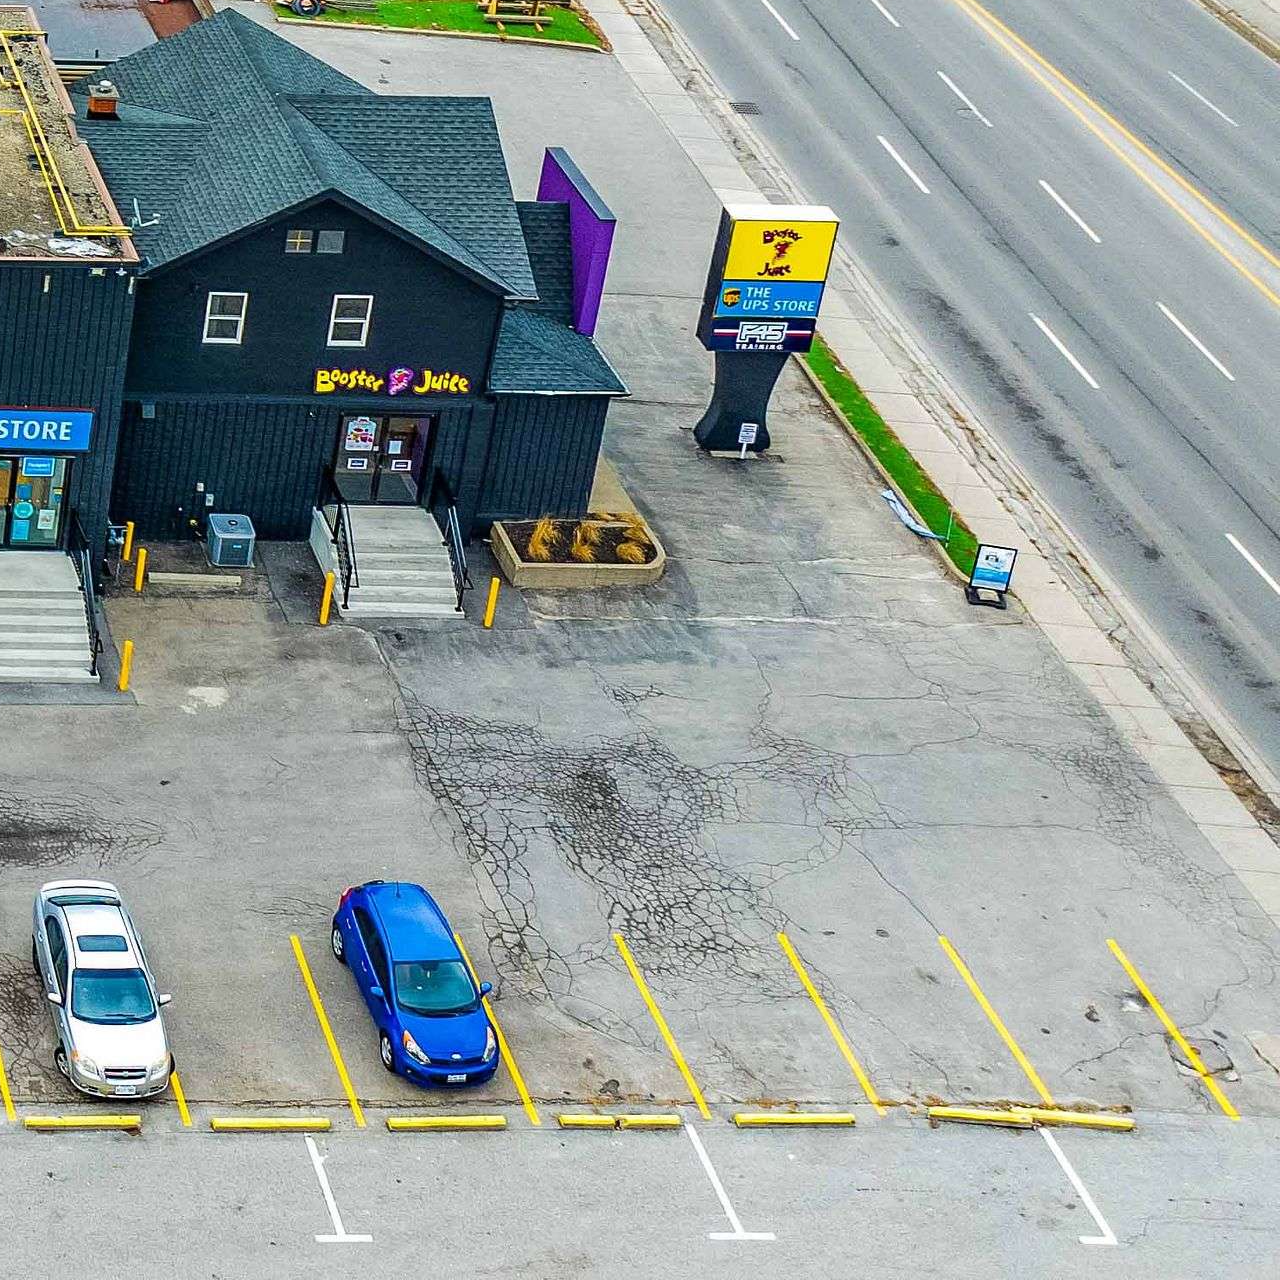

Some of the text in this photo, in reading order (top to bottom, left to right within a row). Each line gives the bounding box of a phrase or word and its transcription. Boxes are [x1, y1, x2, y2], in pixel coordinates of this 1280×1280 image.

[746, 287, 772, 298] THE
[742, 300, 816, 312] UPS STORE
[739, 323, 786, 341] F45
[315, 369, 470, 394] Booster Juice
